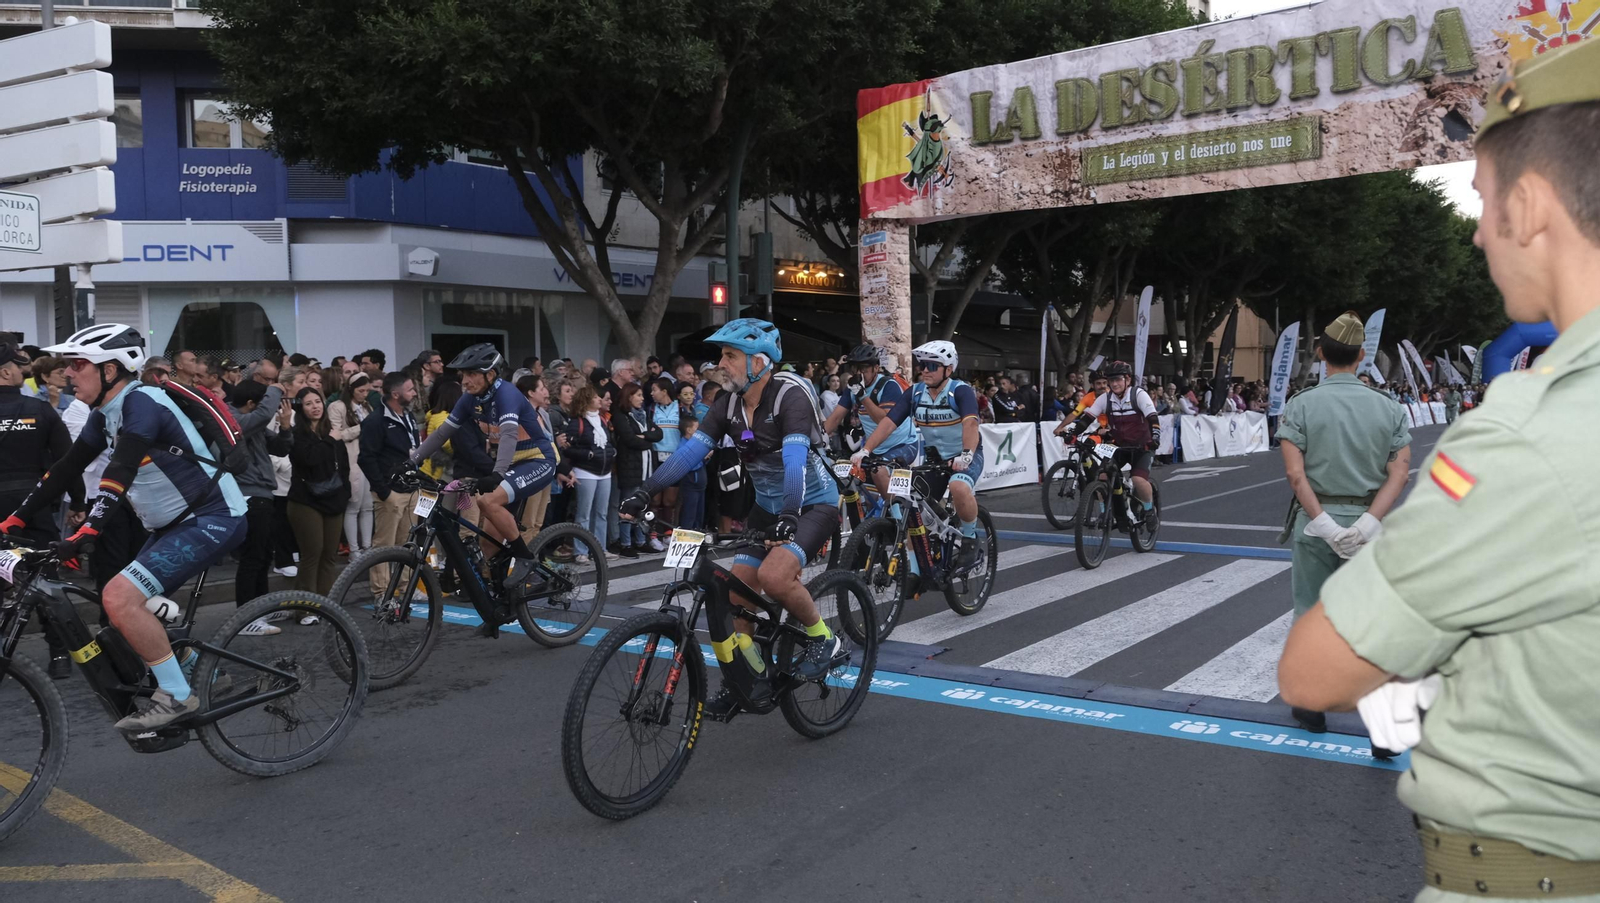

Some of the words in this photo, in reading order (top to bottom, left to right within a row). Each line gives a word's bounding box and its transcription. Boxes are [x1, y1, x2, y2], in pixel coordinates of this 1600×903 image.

[970, 86, 1042, 145] LA
[1055, 7, 1479, 135] DESÉRTICA
[1103, 155, 1115, 170] La
[1120, 151, 1155, 169] Legión
[1161, 151, 1169, 166] y
[1174, 146, 1185, 161] el
[1190, 141, 1237, 159] desierto
[1243, 139, 1263, 152] nos
[1270, 135, 1292, 149] une
[182, 163, 252, 177] Logopedia
[179, 181, 257, 195] Fisioterapia
[1274, 335, 1292, 392] cajamar
[891, 478, 909, 488] 10033
[988, 696, 1126, 720] cajamar
[1229, 731, 1373, 757] cajama
